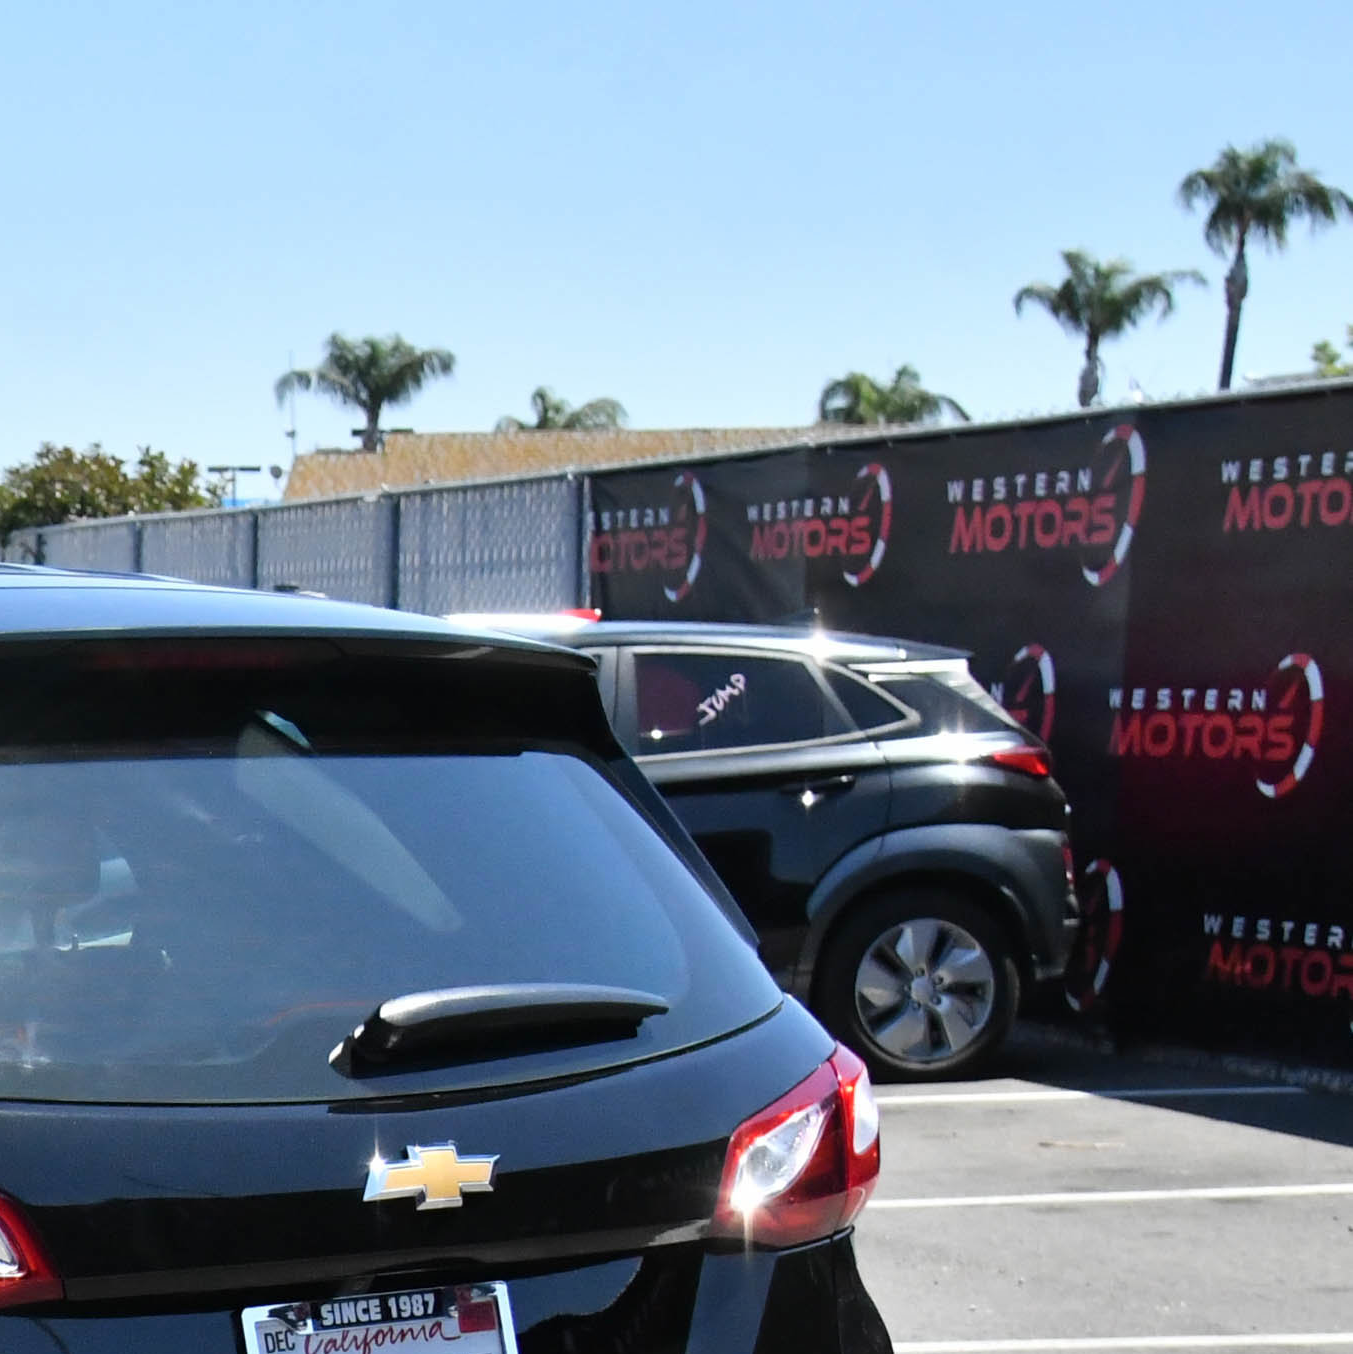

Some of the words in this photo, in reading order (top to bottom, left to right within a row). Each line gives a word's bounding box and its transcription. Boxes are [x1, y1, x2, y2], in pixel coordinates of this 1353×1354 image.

[946, 465, 1093, 504] WESTERN
[746, 496, 851, 522] WESTERN
[1222, 477, 1353, 532] MOTO
[749, 515, 871, 560] MOTORS
[947, 493, 1118, 554] MOTORS
[1108, 687, 1267, 711] WESTERN
[1109, 711, 1295, 760] MOTORS
[1203, 913, 1353, 949] WESTER
[321, 1298, 383, 1328] SINCE
[388, 1292, 436, 1318] 1987
[263, 1328, 296, 1354] DEC
